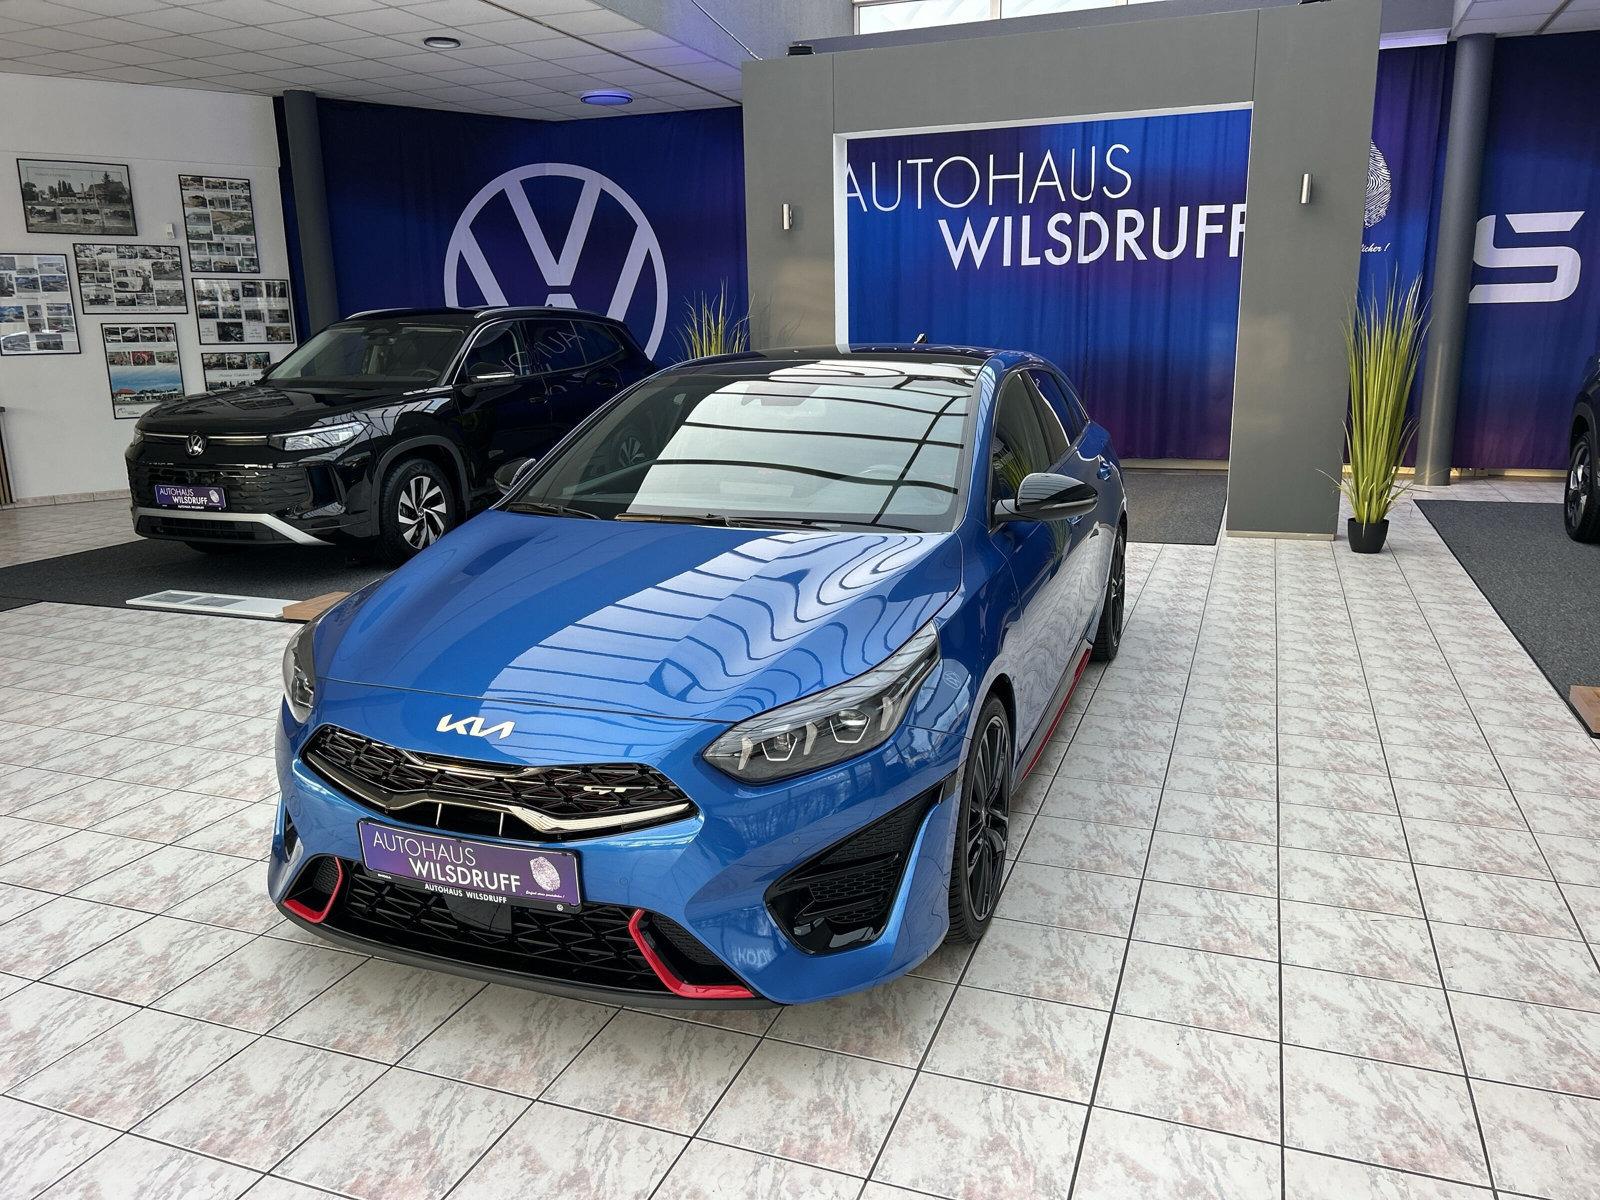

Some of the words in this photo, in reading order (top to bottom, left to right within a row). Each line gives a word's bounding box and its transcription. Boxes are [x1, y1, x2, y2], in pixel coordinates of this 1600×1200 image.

[846, 143, 1132, 213] AUTOHAUS
[159, 487, 194, 496] AUTOHAUS
[172, 495, 208, 505] WILSDRUFF
[436, 713, 516, 740] KIA
[373, 830, 476, 867] AUTOHAUS
[408, 857, 521, 893] WILSDRUFF
[425, 883, 463, 897] AUTOHAUS
[466, 891, 508, 904] WILSDRUFF
